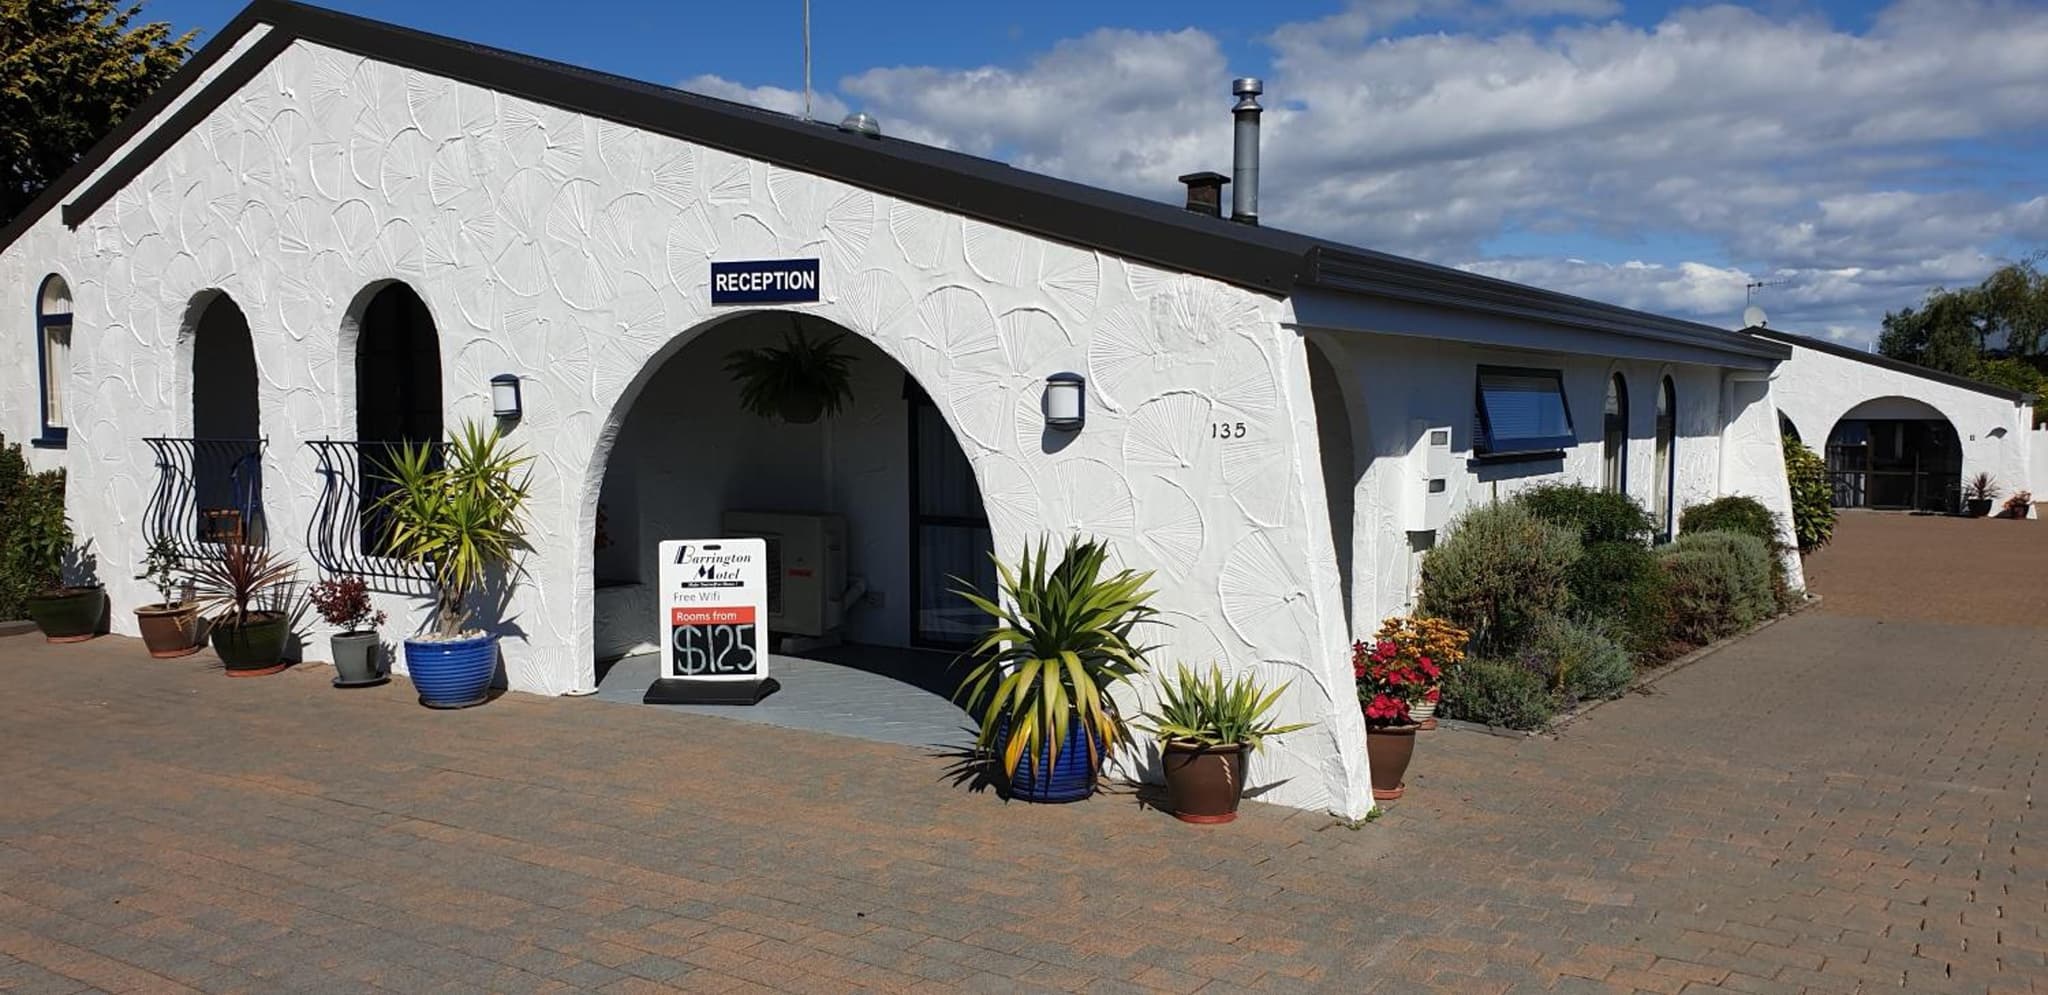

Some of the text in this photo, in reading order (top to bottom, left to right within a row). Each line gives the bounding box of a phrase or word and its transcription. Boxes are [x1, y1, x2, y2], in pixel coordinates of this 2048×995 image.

[716, 271, 814, 291] RECEPTION
[1212, 422, 1246, 439] 135
[674, 545, 752, 565] Barrington
[694, 564, 740, 580] Motel
[674, 591, 721, 601] Free Wifi
[676, 611, 737, 621] Rooms from
[673, 624, 756, 675] $125
